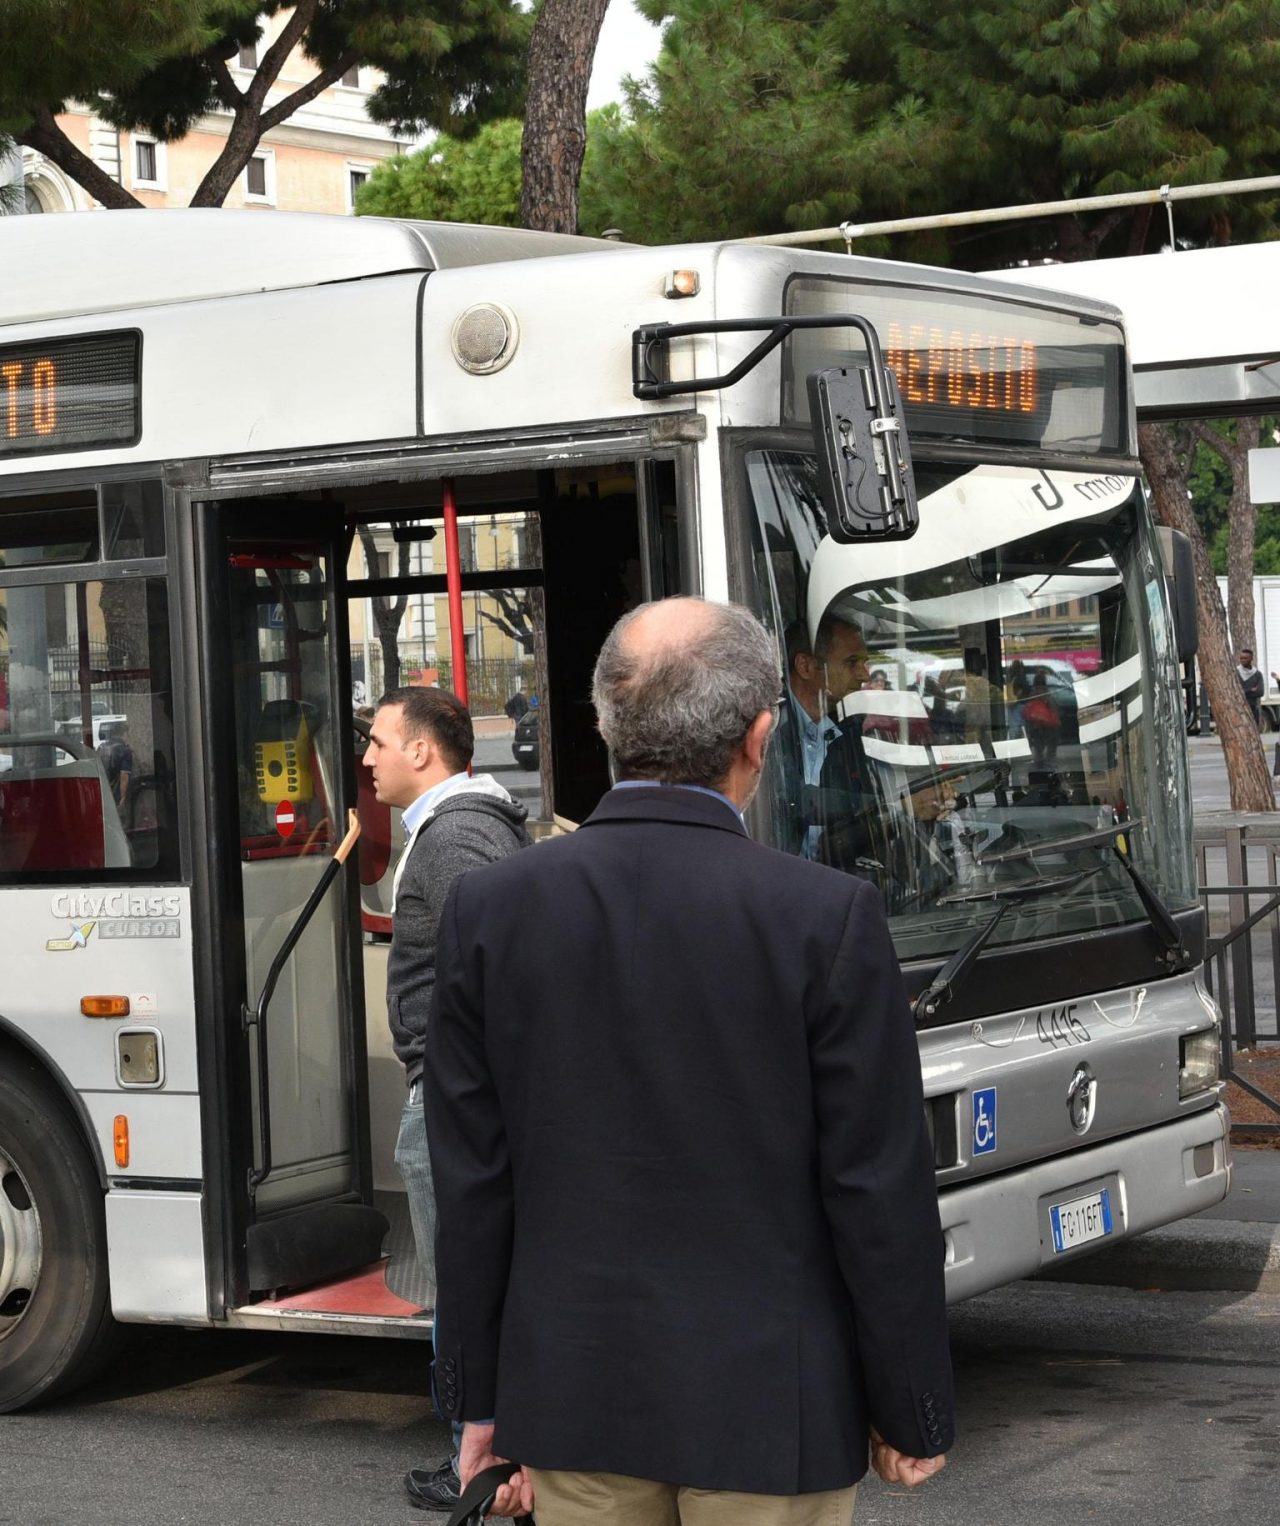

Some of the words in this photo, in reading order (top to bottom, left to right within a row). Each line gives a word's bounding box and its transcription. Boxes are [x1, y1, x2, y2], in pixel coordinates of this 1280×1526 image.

[51, 891, 181, 918] CityClass
[102, 921, 179, 936] CURSOR
[1036, 1004, 1092, 1049] 4415
